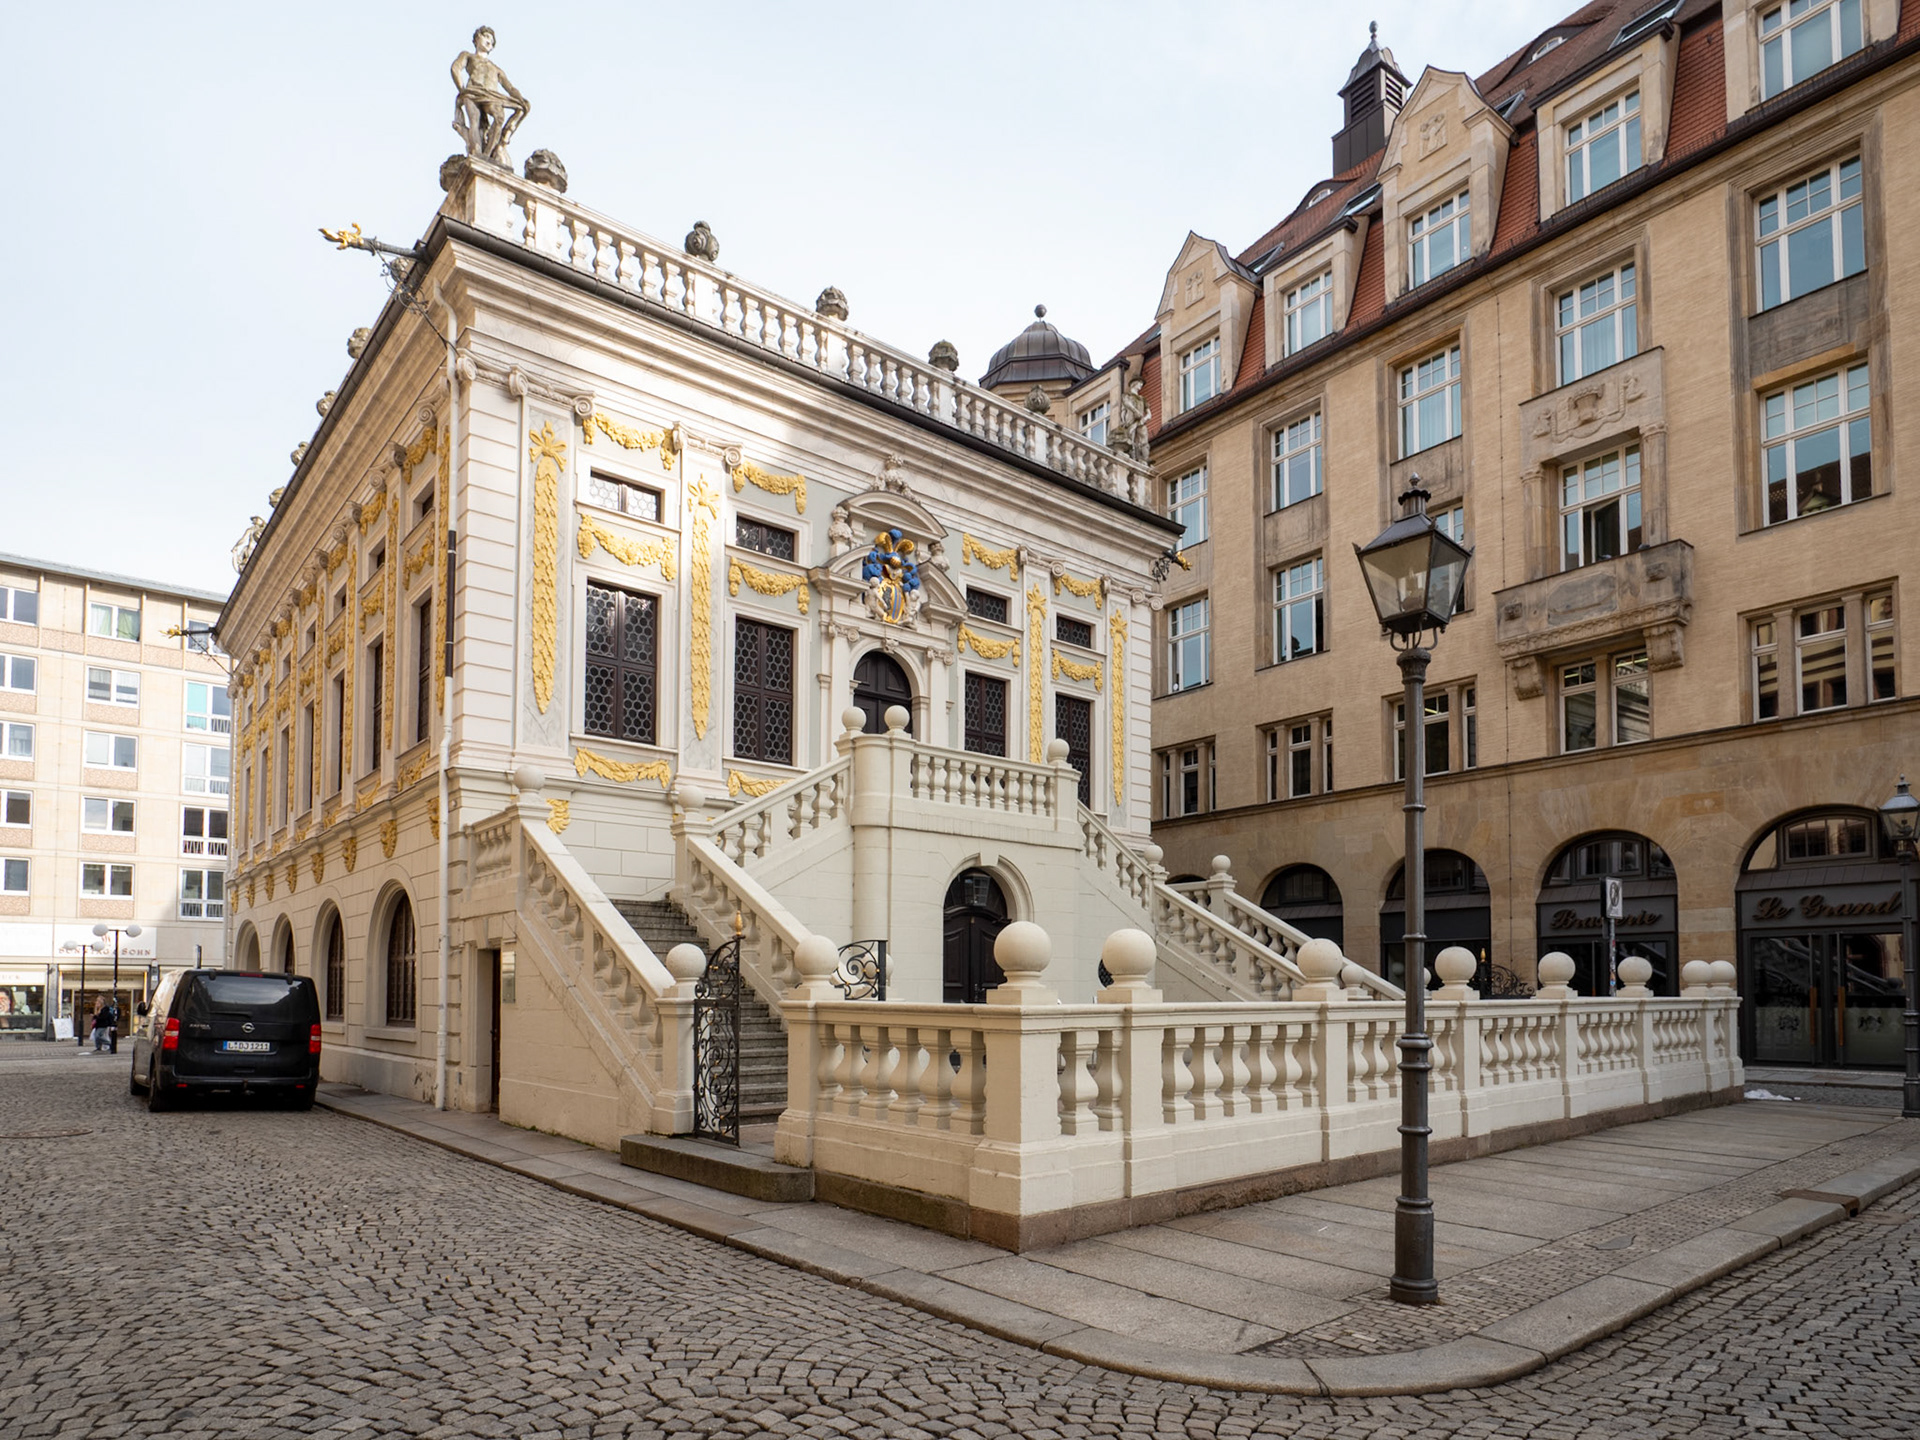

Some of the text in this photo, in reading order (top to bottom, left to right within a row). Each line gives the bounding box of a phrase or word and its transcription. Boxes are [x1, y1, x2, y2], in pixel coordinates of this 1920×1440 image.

[1752, 891, 1903, 920] Le Grand
[1551, 908, 1662, 929] Braserie
